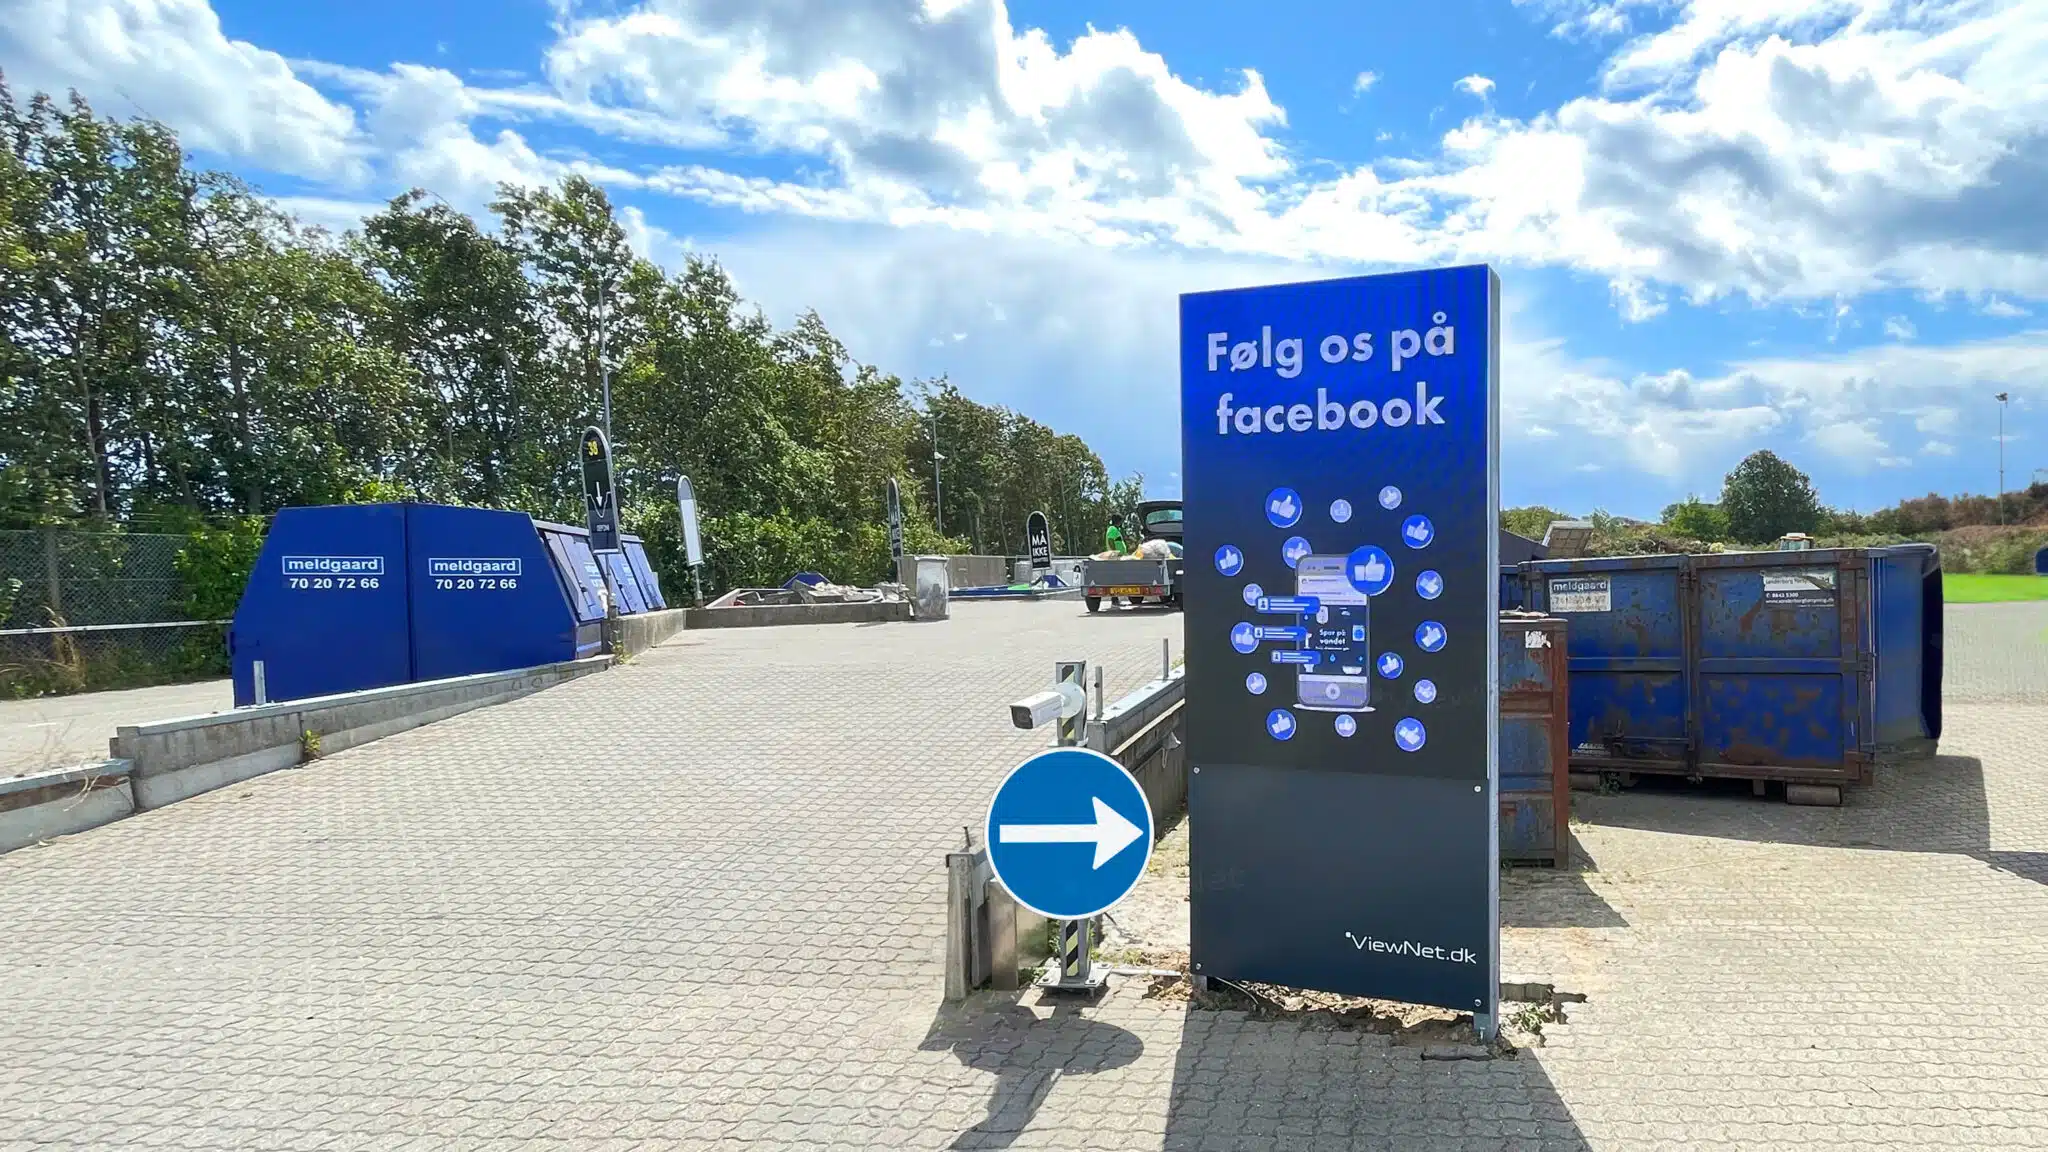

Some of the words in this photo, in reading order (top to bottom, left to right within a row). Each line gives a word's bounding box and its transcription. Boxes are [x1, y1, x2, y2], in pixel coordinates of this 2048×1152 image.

[1207, 325, 1303, 379] Følg
[1319, 332, 1374, 363] os
[1391, 311, 1455, 372] på
[1216, 381, 1445, 435] facebook
[1031, 530, 1048, 546] MÅ
[1032, 546, 1048, 557] IKKE
[288, 558, 378, 573] meldgaard
[434, 560, 516, 574] meldgaard
[289, 578, 308, 589] 70
[313, 578, 332, 589] 20
[337, 578, 356, 589] 72
[360, 578, 379, 589] 66
[435, 579, 453, 590] 70
[457, 579, 475, 590] 20
[479, 579, 496, 590] 72
[500, 579, 517, 590] 66
[1553, 580, 1607, 592] meldgaard
[1346, 931, 1477, 965] ViewNet.dk
